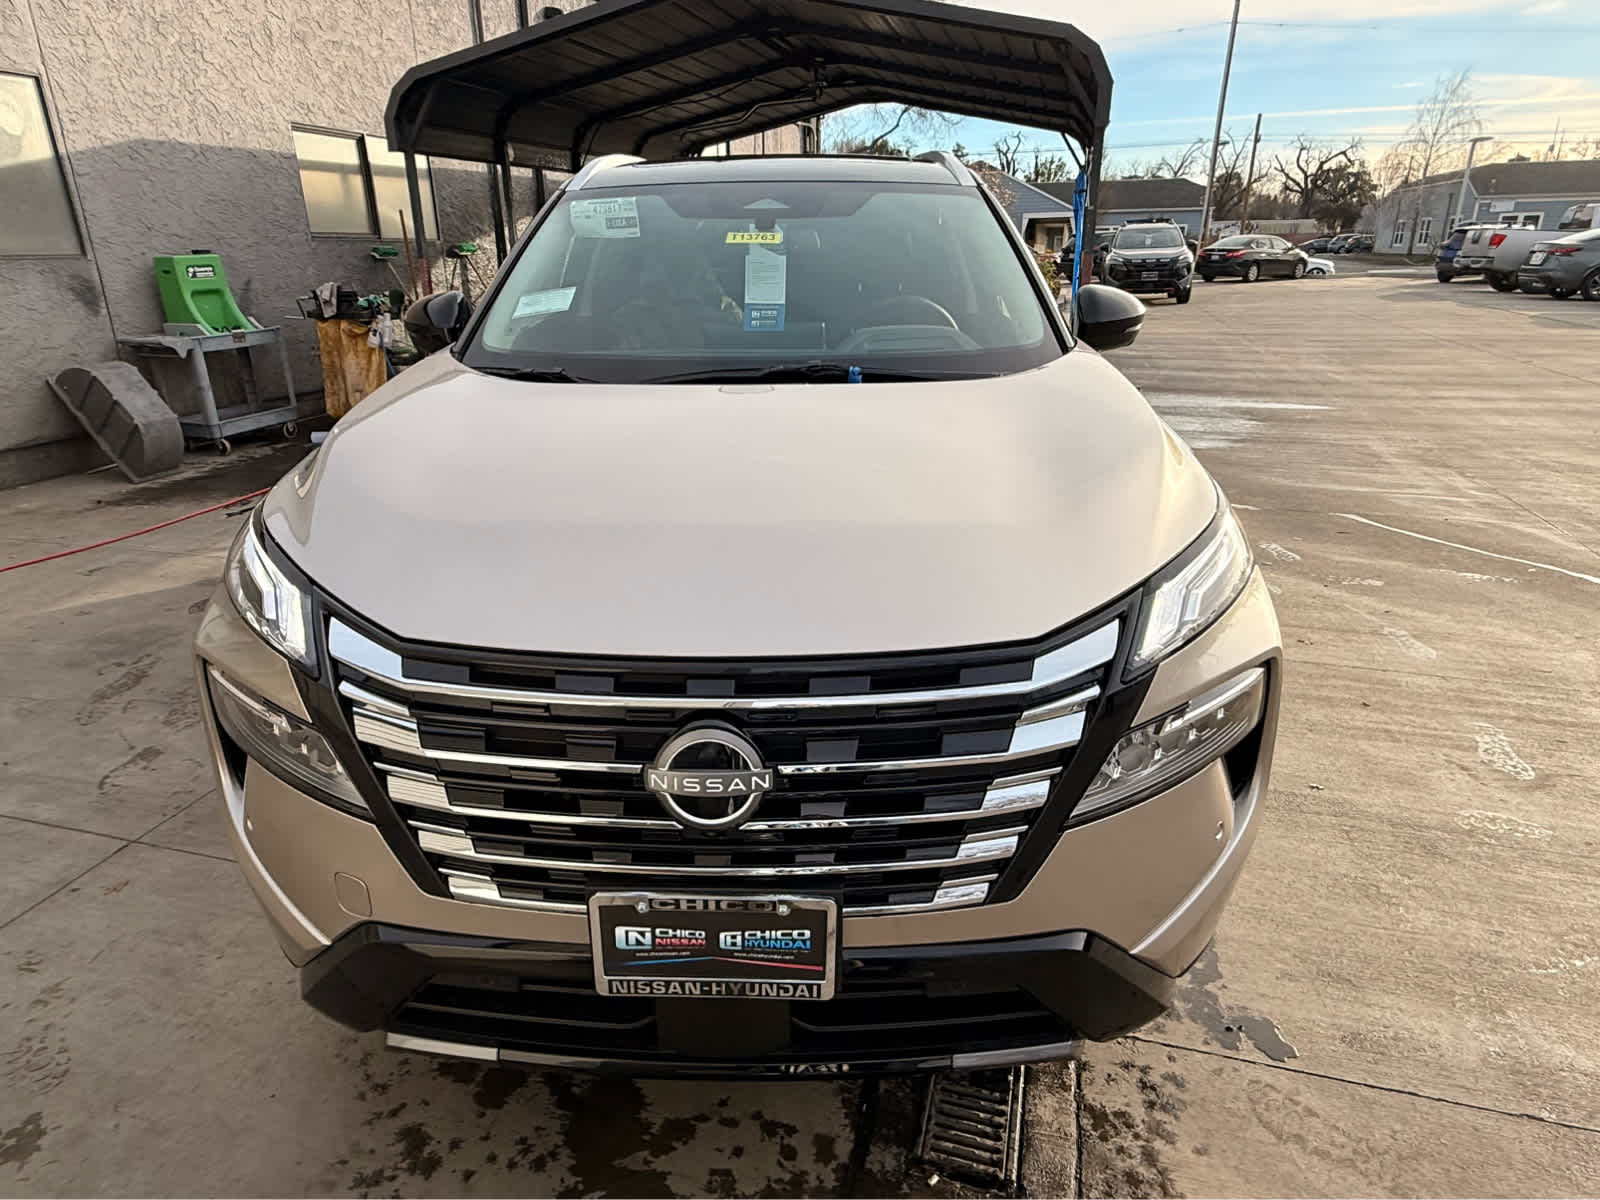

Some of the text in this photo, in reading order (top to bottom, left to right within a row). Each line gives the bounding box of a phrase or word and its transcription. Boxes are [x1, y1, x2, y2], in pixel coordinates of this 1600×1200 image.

[650, 773, 770, 793] NISSAN
[651, 899, 774, 912] CHICO
[654, 928, 706, 939] CHICO
[743, 929, 811, 940] CHICO
[655, 938, 706, 946] NISSAN
[744, 939, 811, 949] HYUNDAI
[611, 980, 818, 998] NISSAN-HYUNDAI
